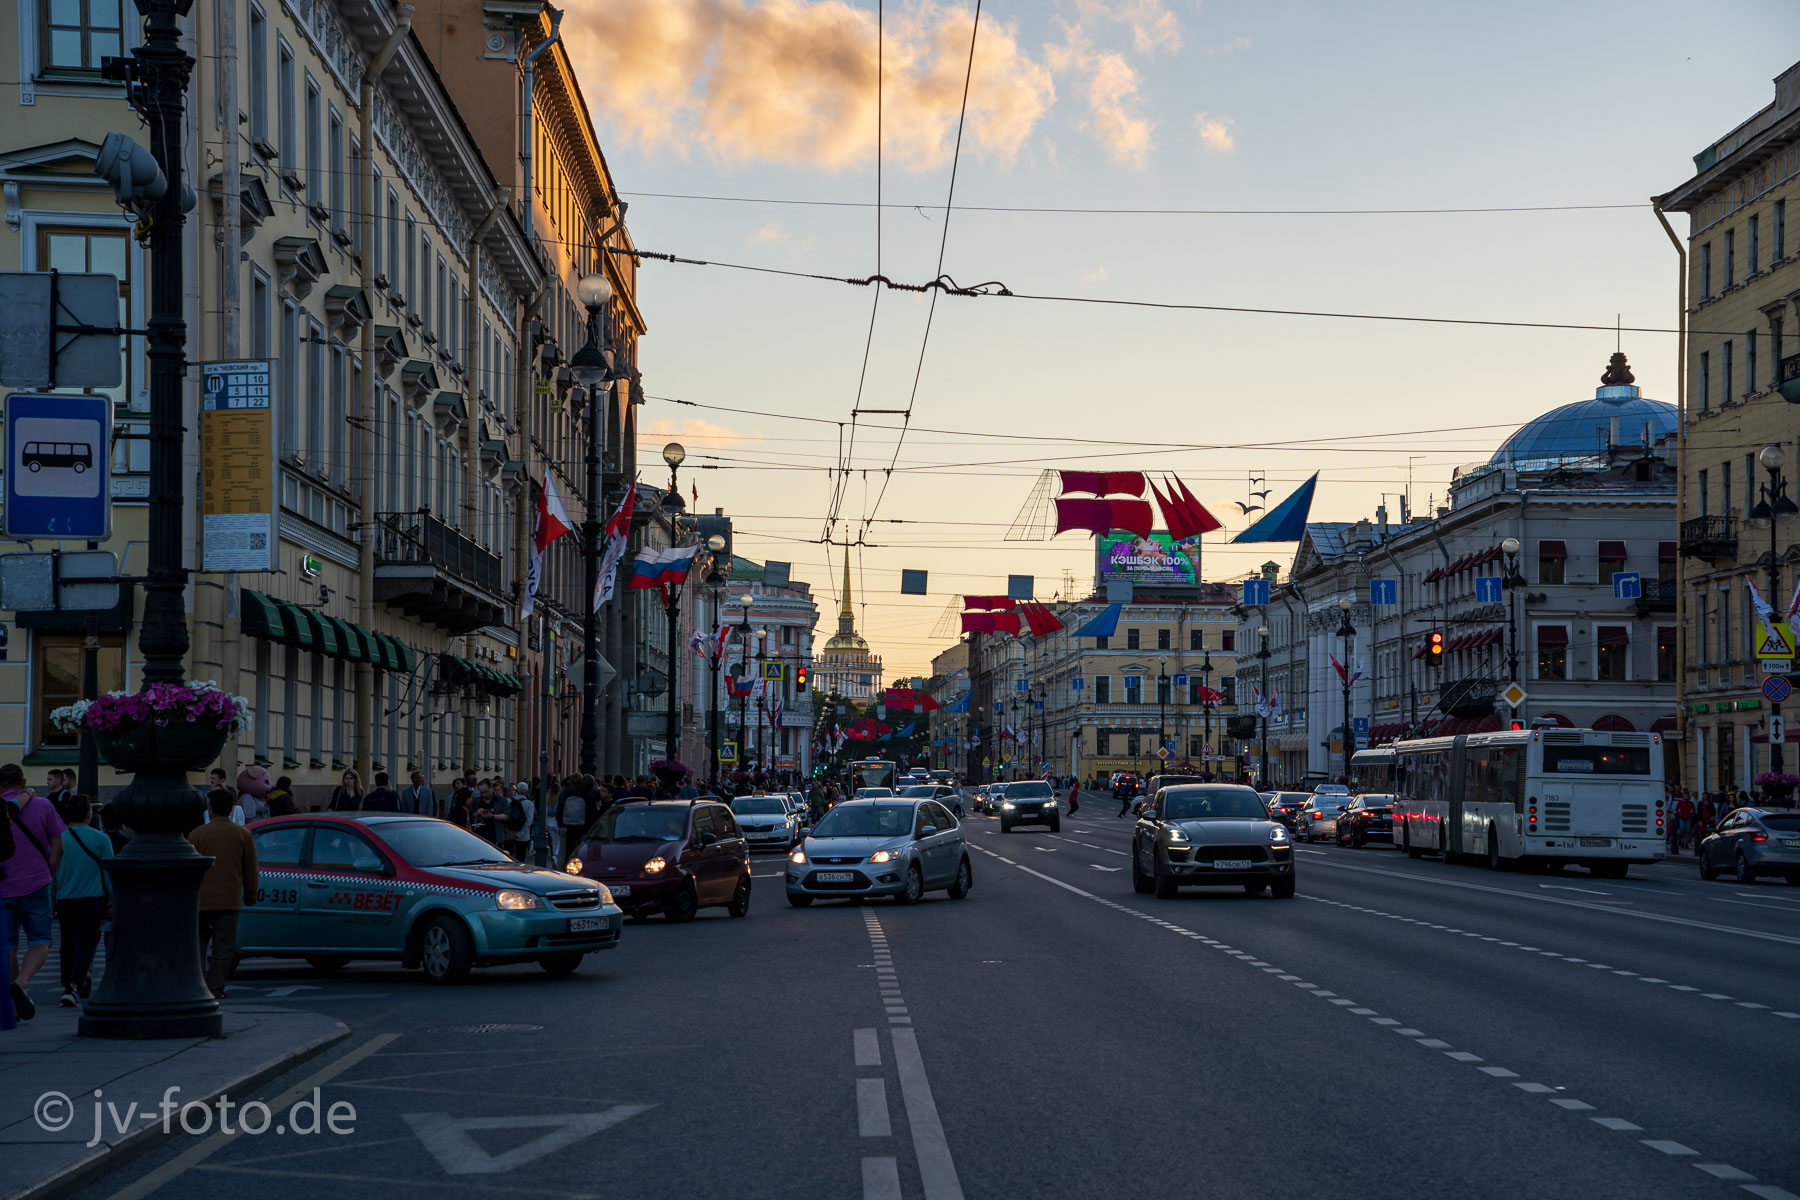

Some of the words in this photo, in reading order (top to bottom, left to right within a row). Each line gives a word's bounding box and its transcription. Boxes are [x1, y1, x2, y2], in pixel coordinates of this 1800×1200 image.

[234, 375, 239, 383] 1
[254, 375, 264, 383] 10
[234, 387, 240, 395] 5
[253, 398, 264, 406] 22
[1111, 556, 1159, 565] КЭШБЭК
[1162, 557, 1189, 566] 100%
[353, 890, 404, 911] ВЕЗЁТ
